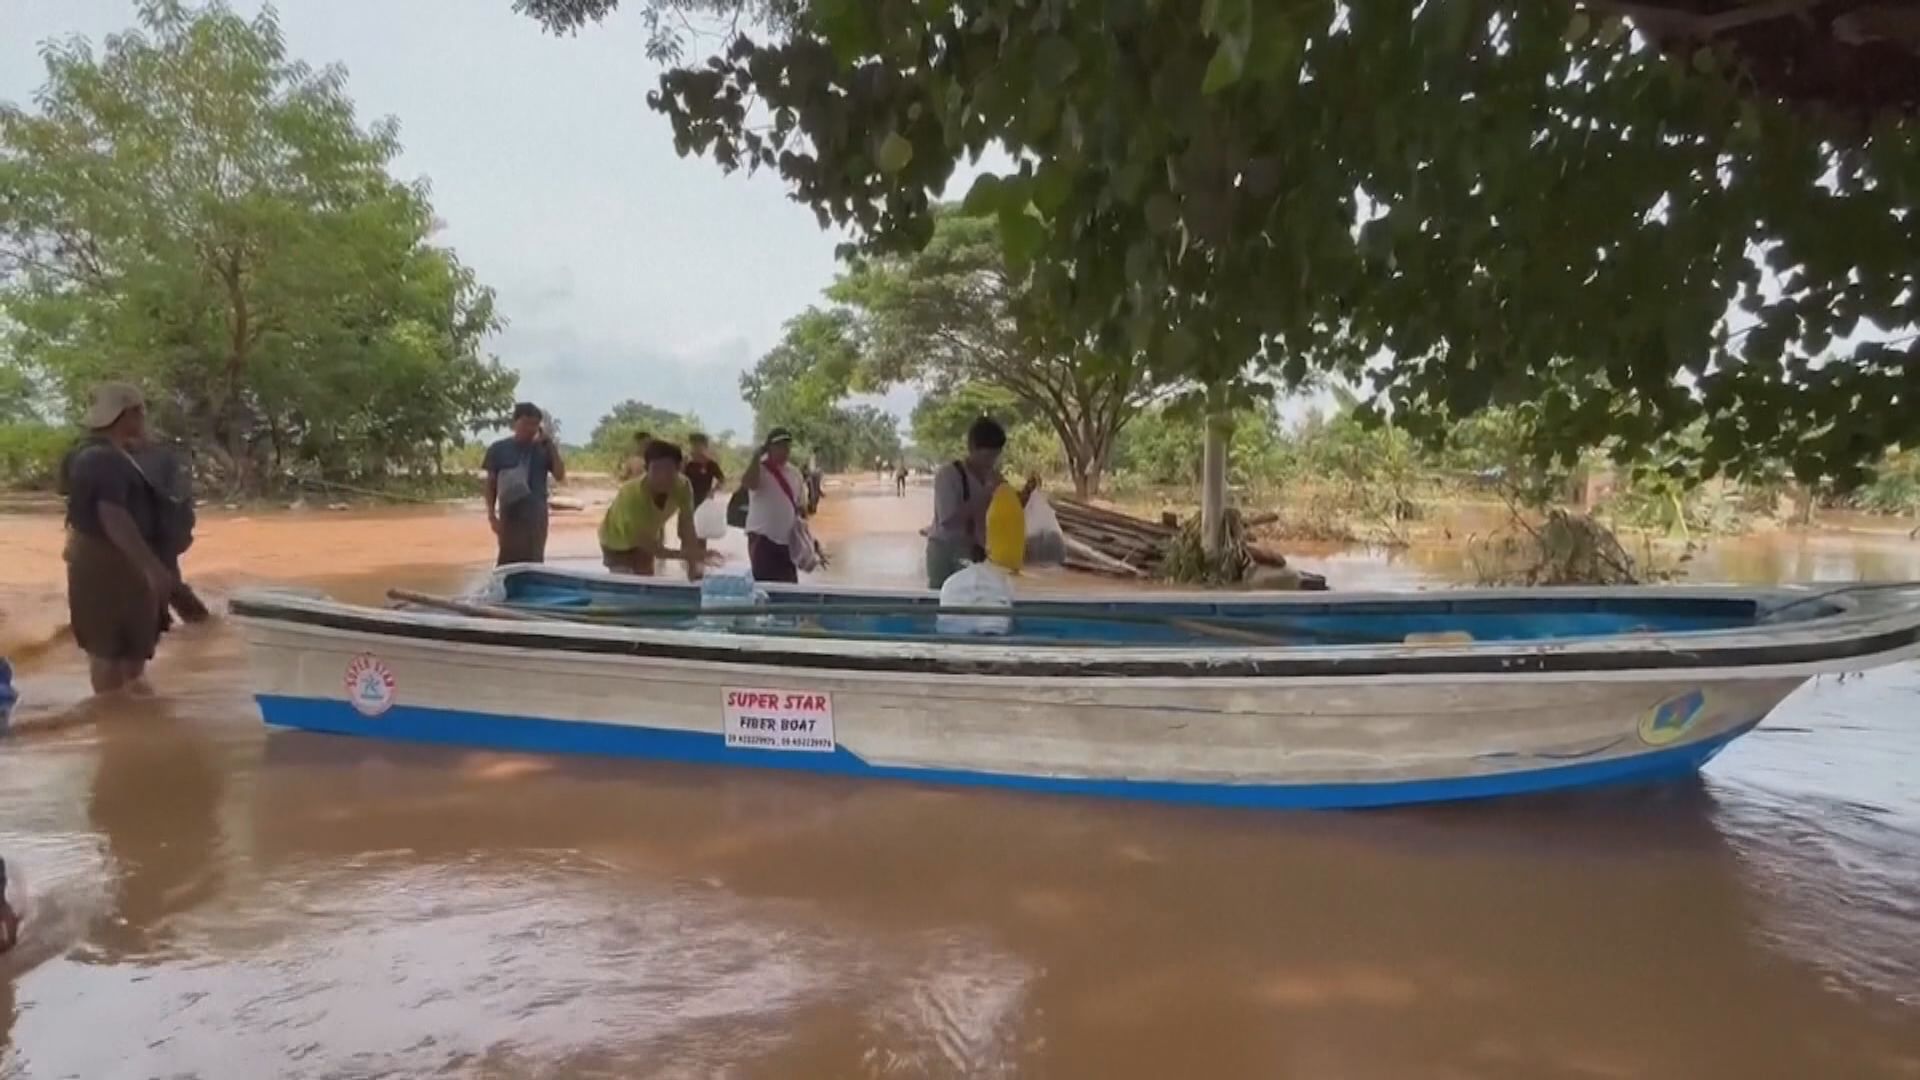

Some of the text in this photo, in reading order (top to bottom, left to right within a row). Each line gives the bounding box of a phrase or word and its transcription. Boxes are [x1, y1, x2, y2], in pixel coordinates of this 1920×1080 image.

[728, 692, 826, 712] SUPER STAR
[740, 716, 816, 732] FIBER BOAT
